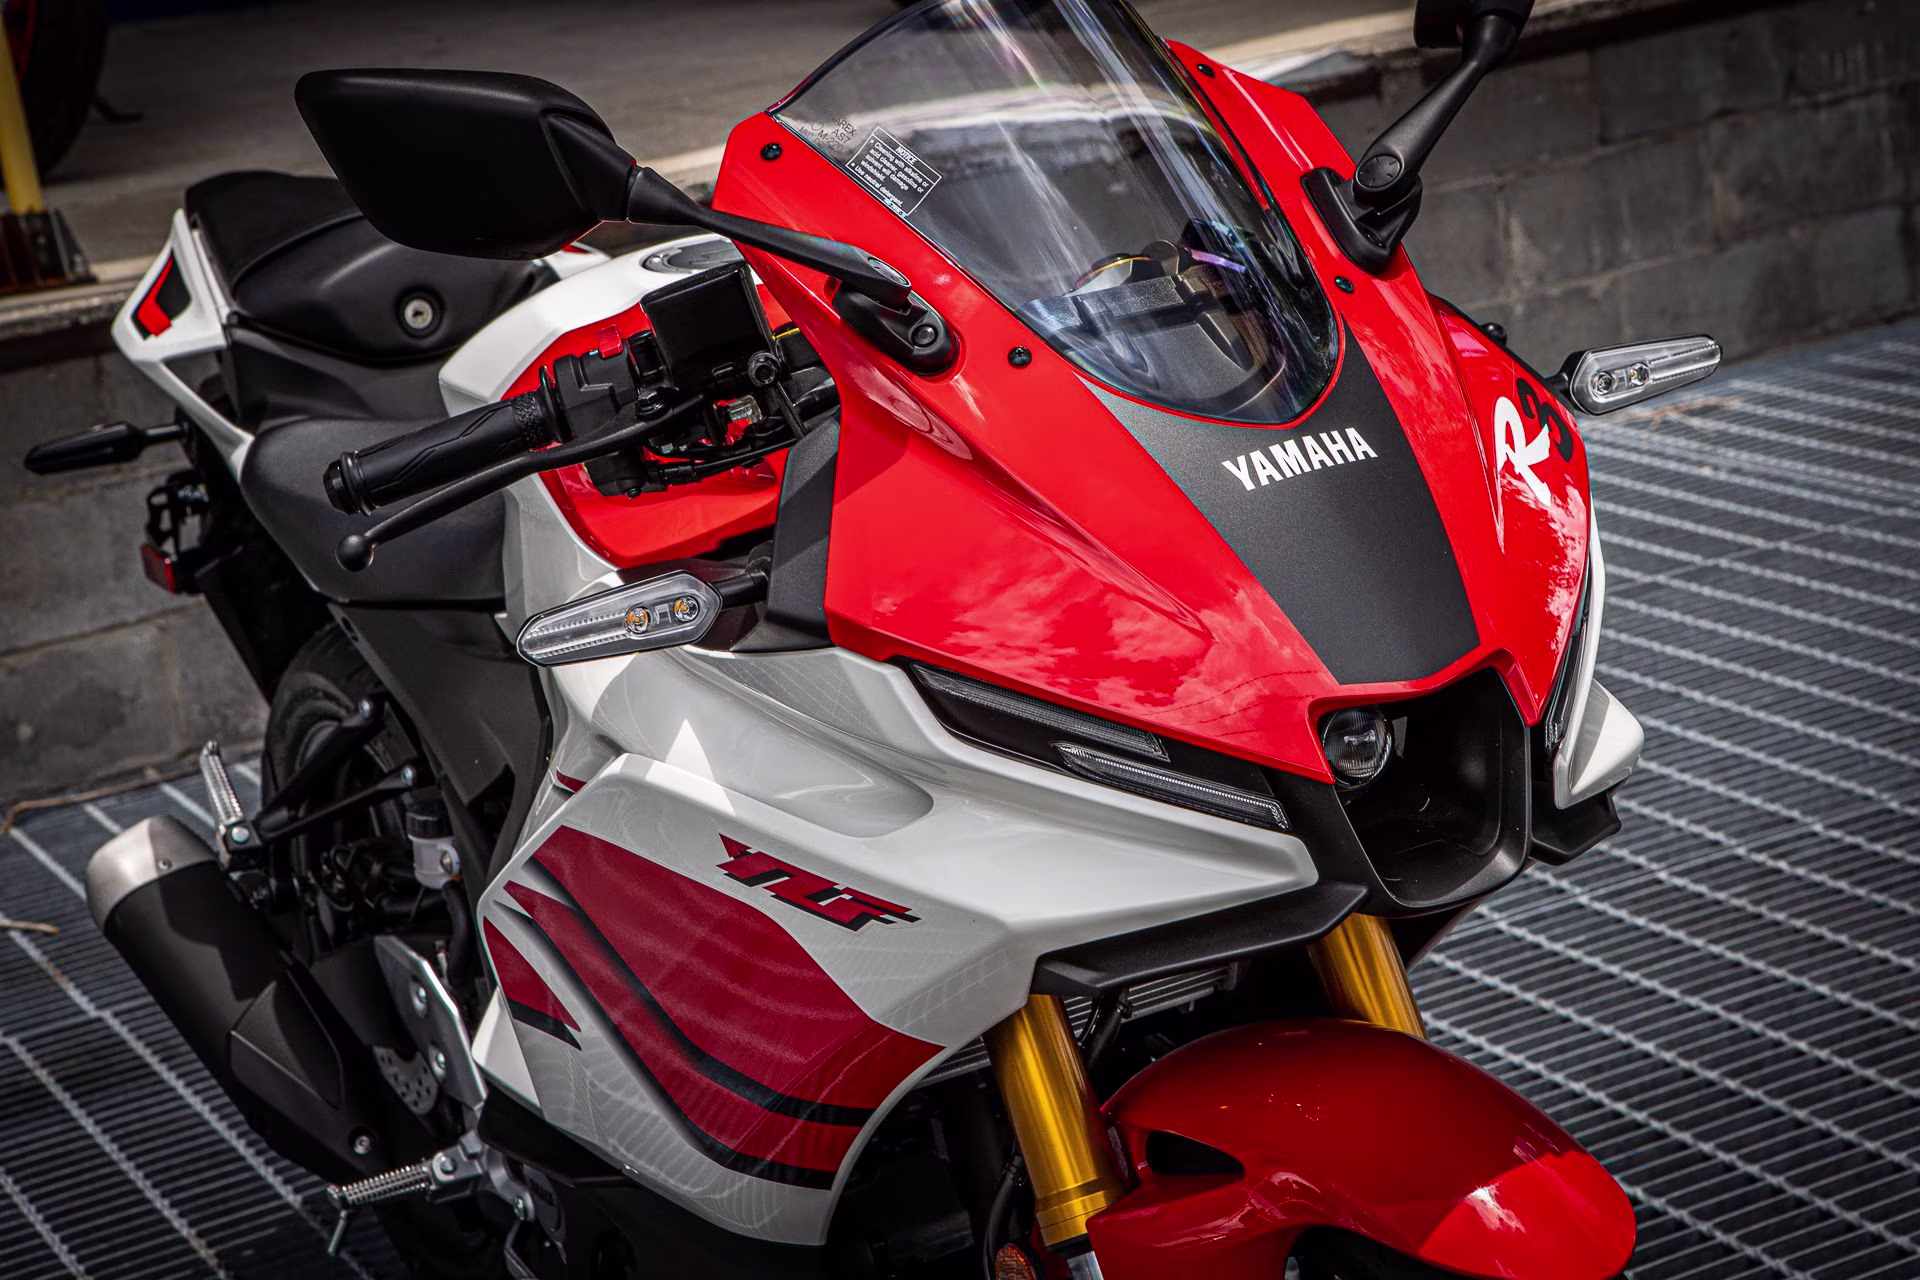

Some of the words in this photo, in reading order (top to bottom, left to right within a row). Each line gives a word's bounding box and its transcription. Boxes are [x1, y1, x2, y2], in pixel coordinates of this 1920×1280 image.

[832, 128, 851, 144] AS7
[865, 154, 883, 170] solvent
[881, 167, 892, 176] will
[889, 173, 909, 191] damage
[869, 148, 881, 159] acid
[896, 171, 918, 189] gasoline
[916, 186, 925, 194] or
[874, 142, 895, 162] Cleaning
[894, 158, 905, 169] with
[904, 166, 923, 183] alkaline
[895, 146, 917, 165] NOTICE
[854, 165, 865, 176] Use
[863, 174, 882, 189] neutral
[1221, 426, 1379, 492] YAMAHA
